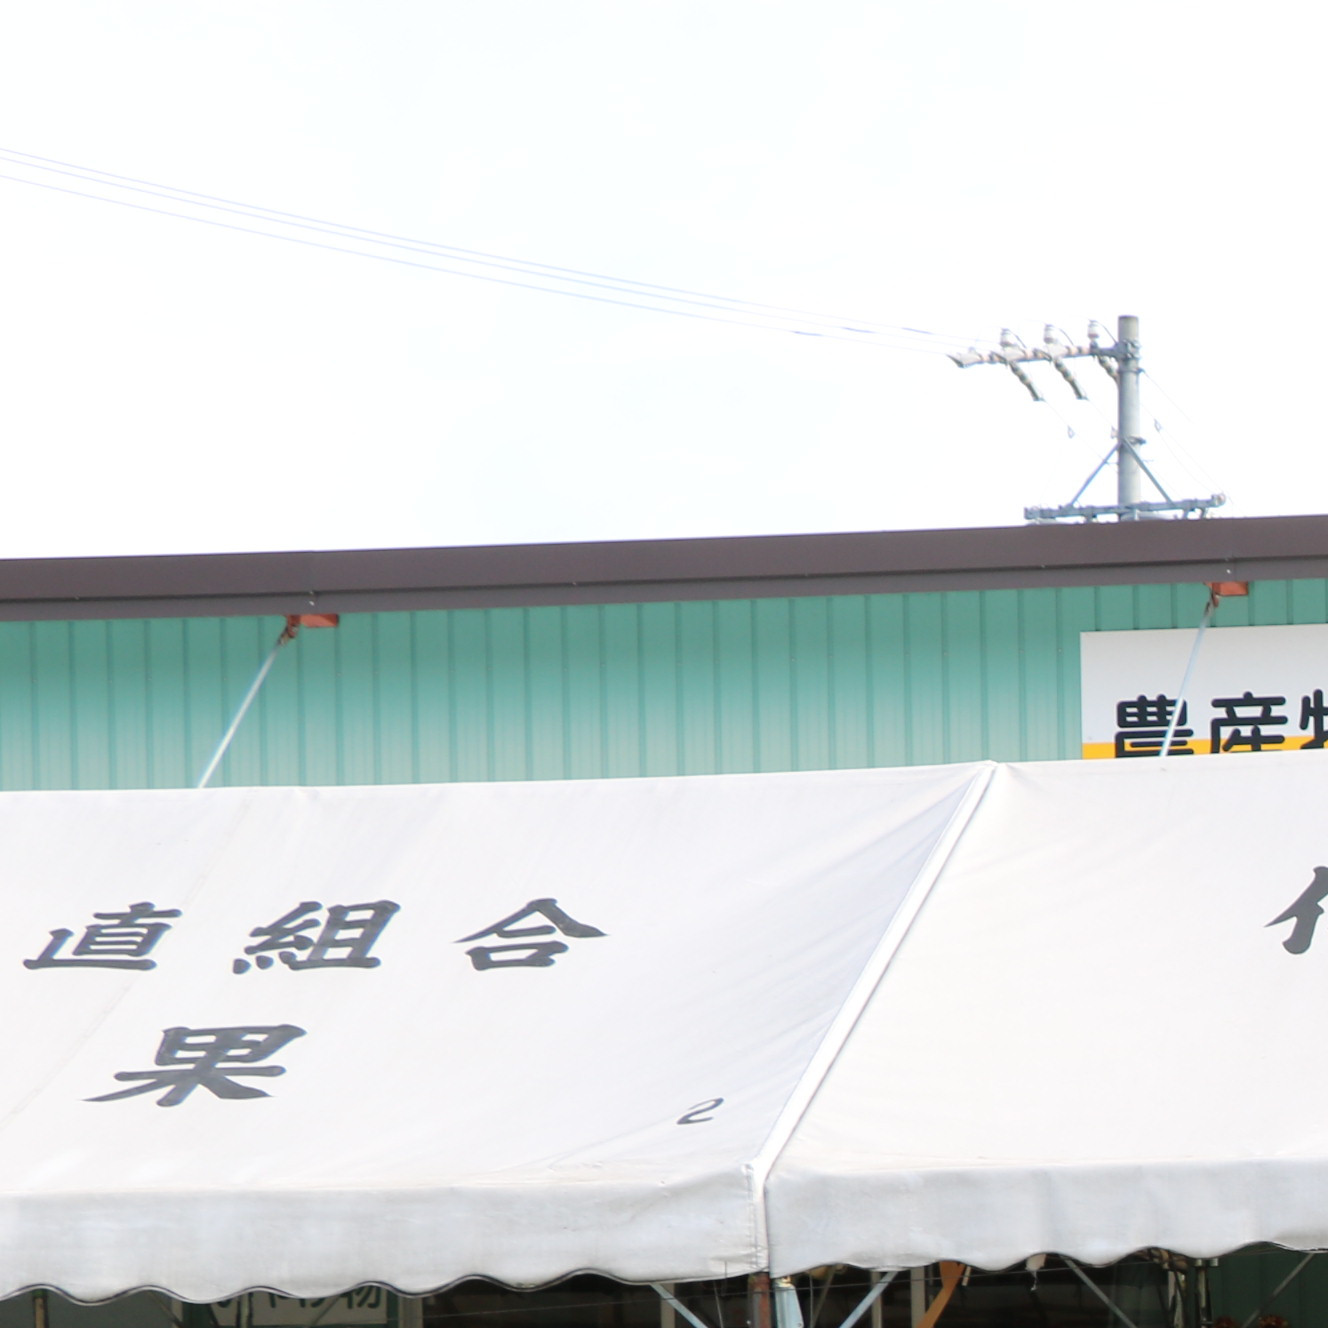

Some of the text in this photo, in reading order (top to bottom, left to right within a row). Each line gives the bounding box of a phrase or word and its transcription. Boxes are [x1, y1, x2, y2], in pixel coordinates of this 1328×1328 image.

[23, 898, 607, 974] 直組合
[83, 1024, 307, 1107] 果
[677, 1097, 725, 1125] 2
